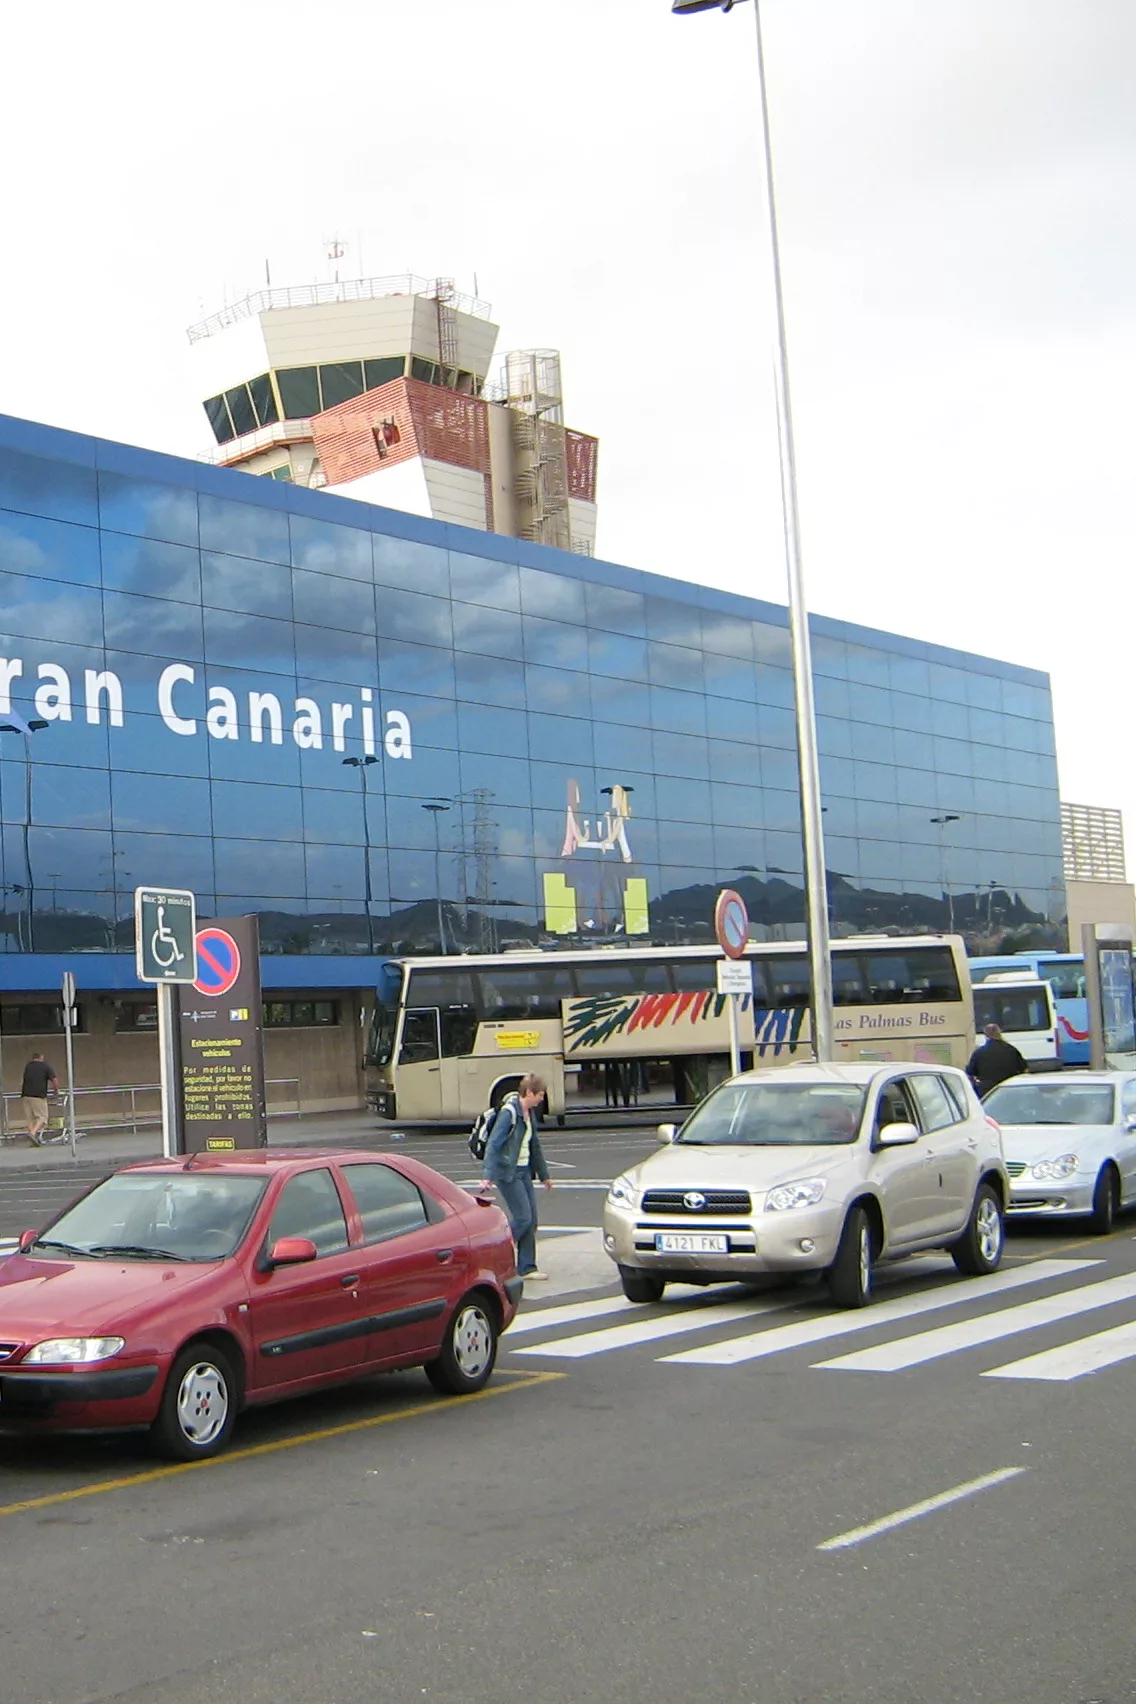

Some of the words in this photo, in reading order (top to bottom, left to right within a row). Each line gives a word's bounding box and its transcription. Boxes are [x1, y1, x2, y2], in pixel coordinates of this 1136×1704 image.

[157, 663, 414, 760] Canaria
[157, 895, 167, 904] 30
[167, 896, 191, 906] minutos
[834, 1018, 852, 1029] as
[859, 1013, 913, 1029] Palmas
[919, 1011, 946, 1026] Bus
[191, 1039, 242, 1048] Estacionamiento
[183, 1066, 197, 1074] Por
[202, 1065, 236, 1074] medidas
[241, 1064, 252, 1073] de
[215, 1075, 226, 1084] por
[226, 1074, 243, 1082] favor
[184, 1094, 210, 1103] lugares
[214, 1102, 227, 1111] las
[232, 1103, 254, 1111] zonas
[185, 1112, 223, 1120] destinadas
[208, 1140, 233, 1149] TARIFAS
[665, 1237, 694, 1250] 4121
[701, 1237, 724, 1251] FKL
